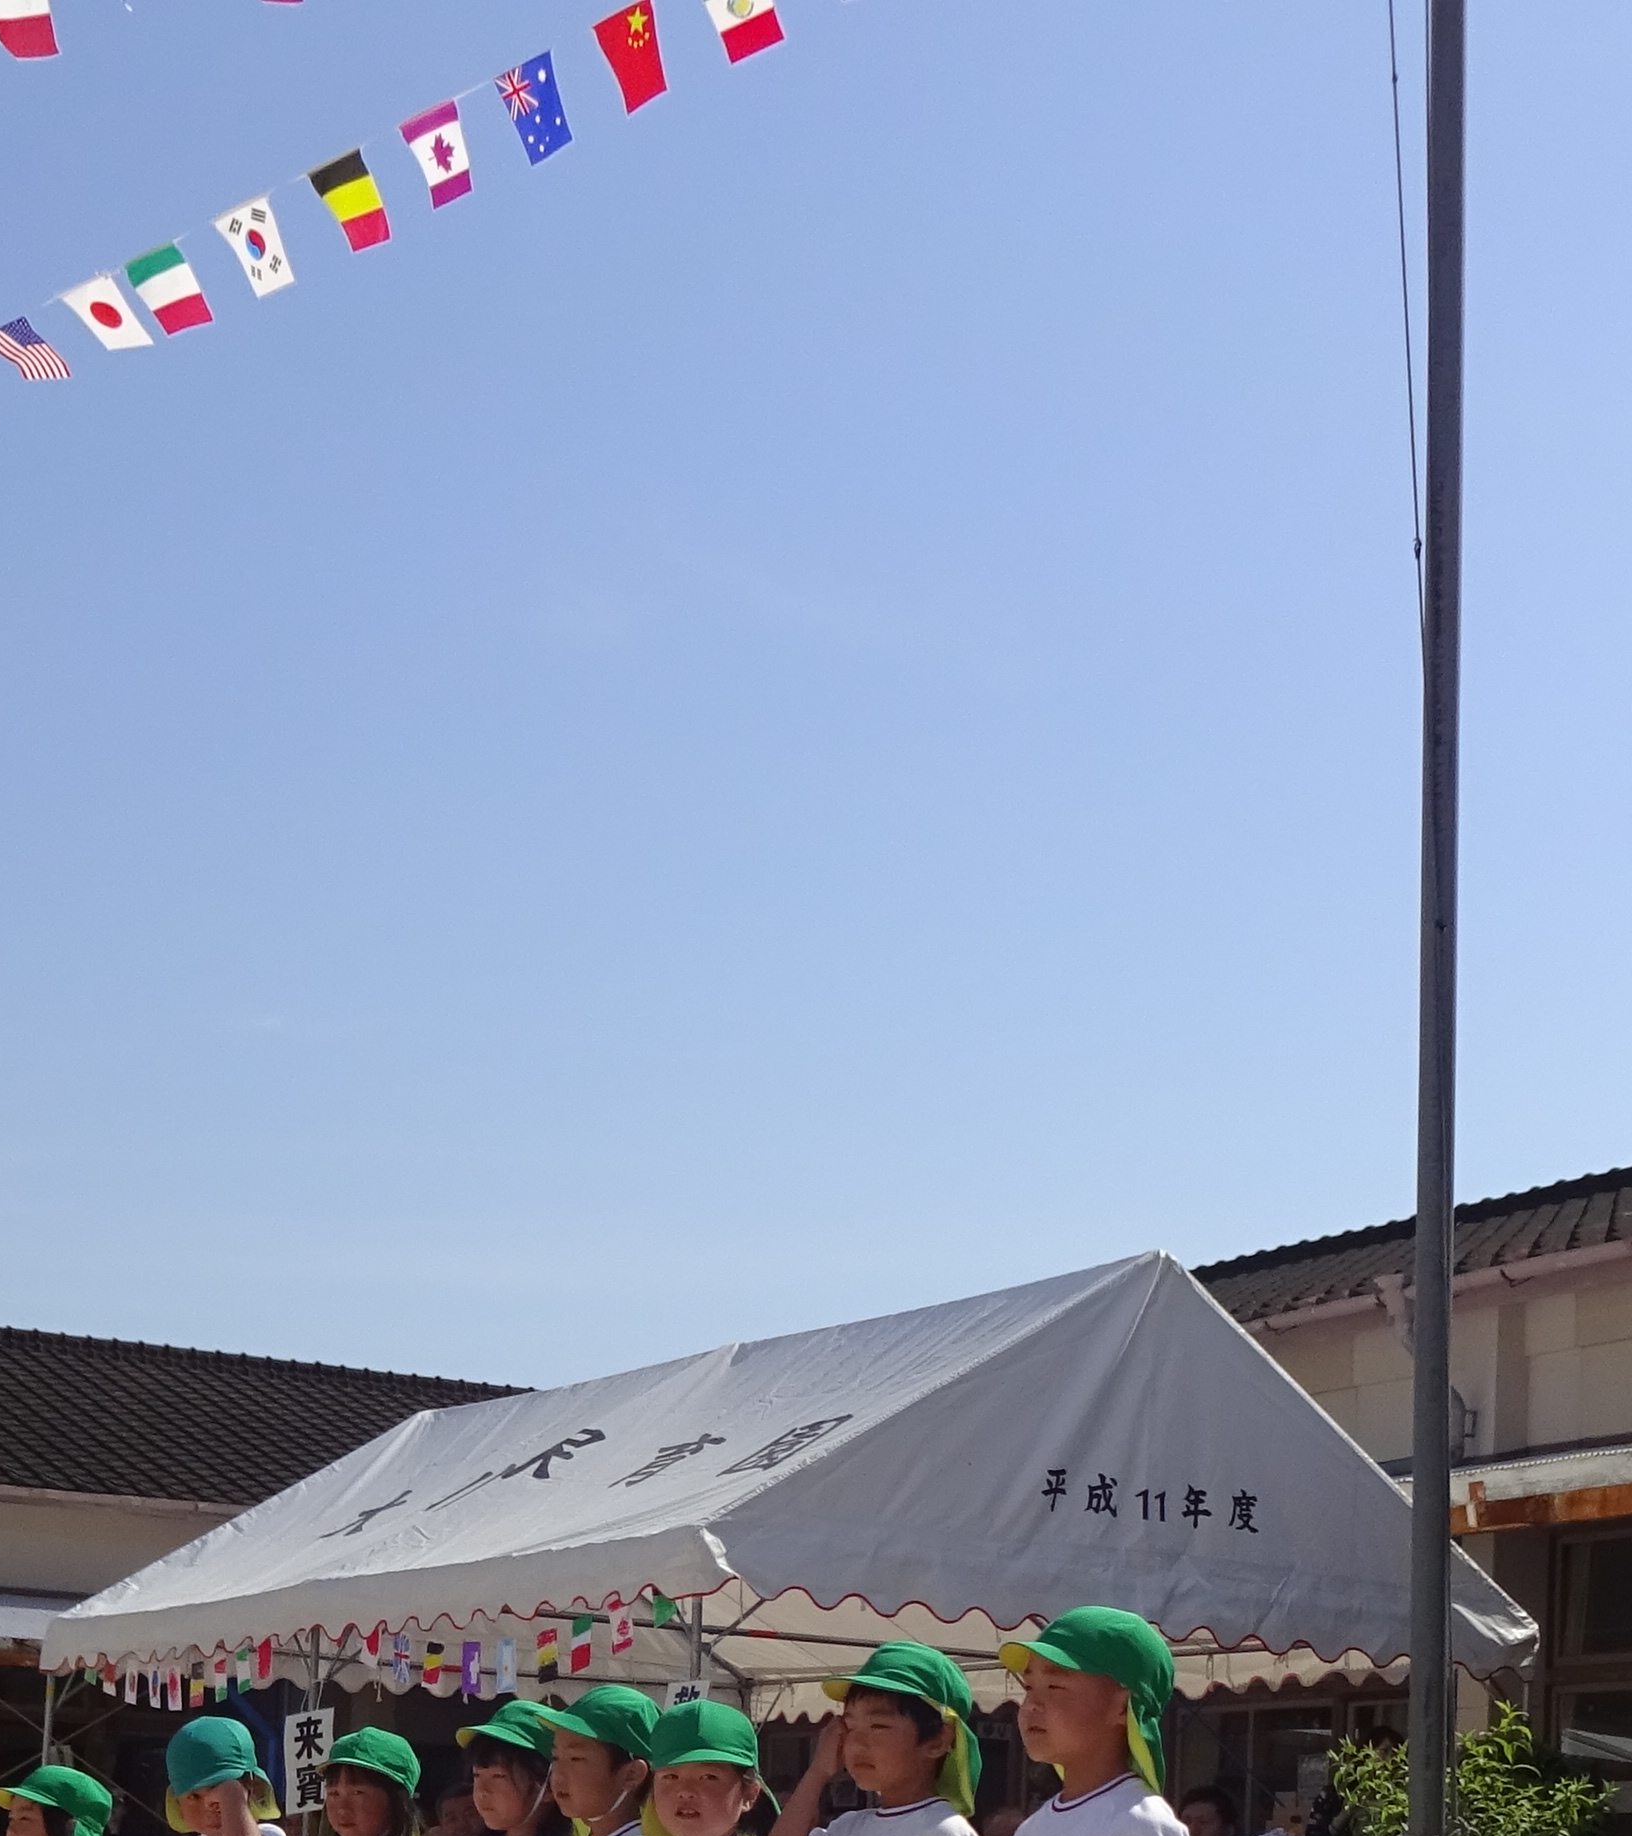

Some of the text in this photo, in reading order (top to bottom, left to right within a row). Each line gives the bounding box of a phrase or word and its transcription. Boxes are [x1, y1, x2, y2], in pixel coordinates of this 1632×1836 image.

[1041, 1468, 1260, 1534] 平成11年度
[294, 1716, 325, 1808] 来賓
